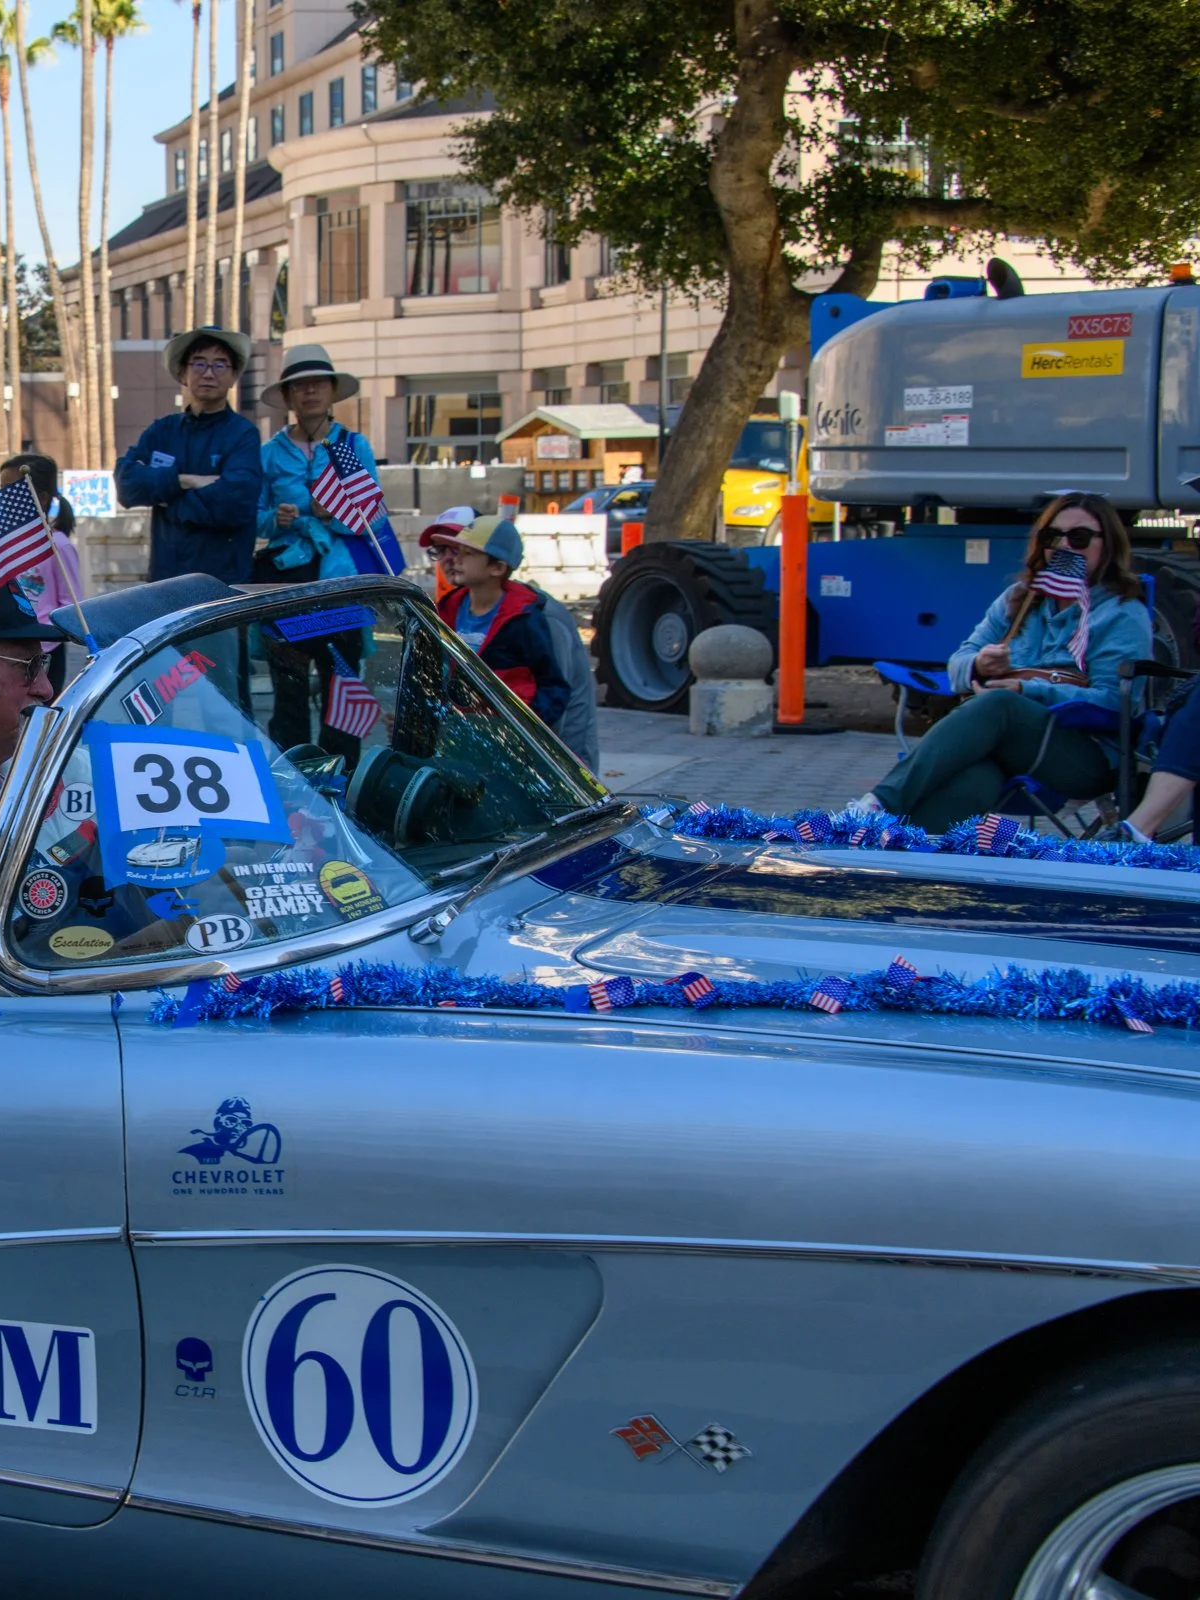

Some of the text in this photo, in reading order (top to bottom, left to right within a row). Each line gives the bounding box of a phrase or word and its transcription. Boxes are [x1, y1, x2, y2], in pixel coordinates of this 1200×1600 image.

[1069, 316, 1132, 335] XX5C73
[153, 650, 217, 705] IMSA
[133, 753, 230, 814] 38
[65, 789, 93, 814] B1
[232, 862, 314, 877] IN MEMORY
[272, 873, 286, 884] OF
[245, 883, 320, 900] GENE
[245, 894, 325, 920] HAMBY
[52, 936, 111, 949] Escalation
[196, 917, 245, 949] PB
[172, 1169, 285, 1185] CHEVROLET
[172, 1187, 285, 1196] ONE HUNDRED YEARS
[266, 1292, 454, 1475] 60
